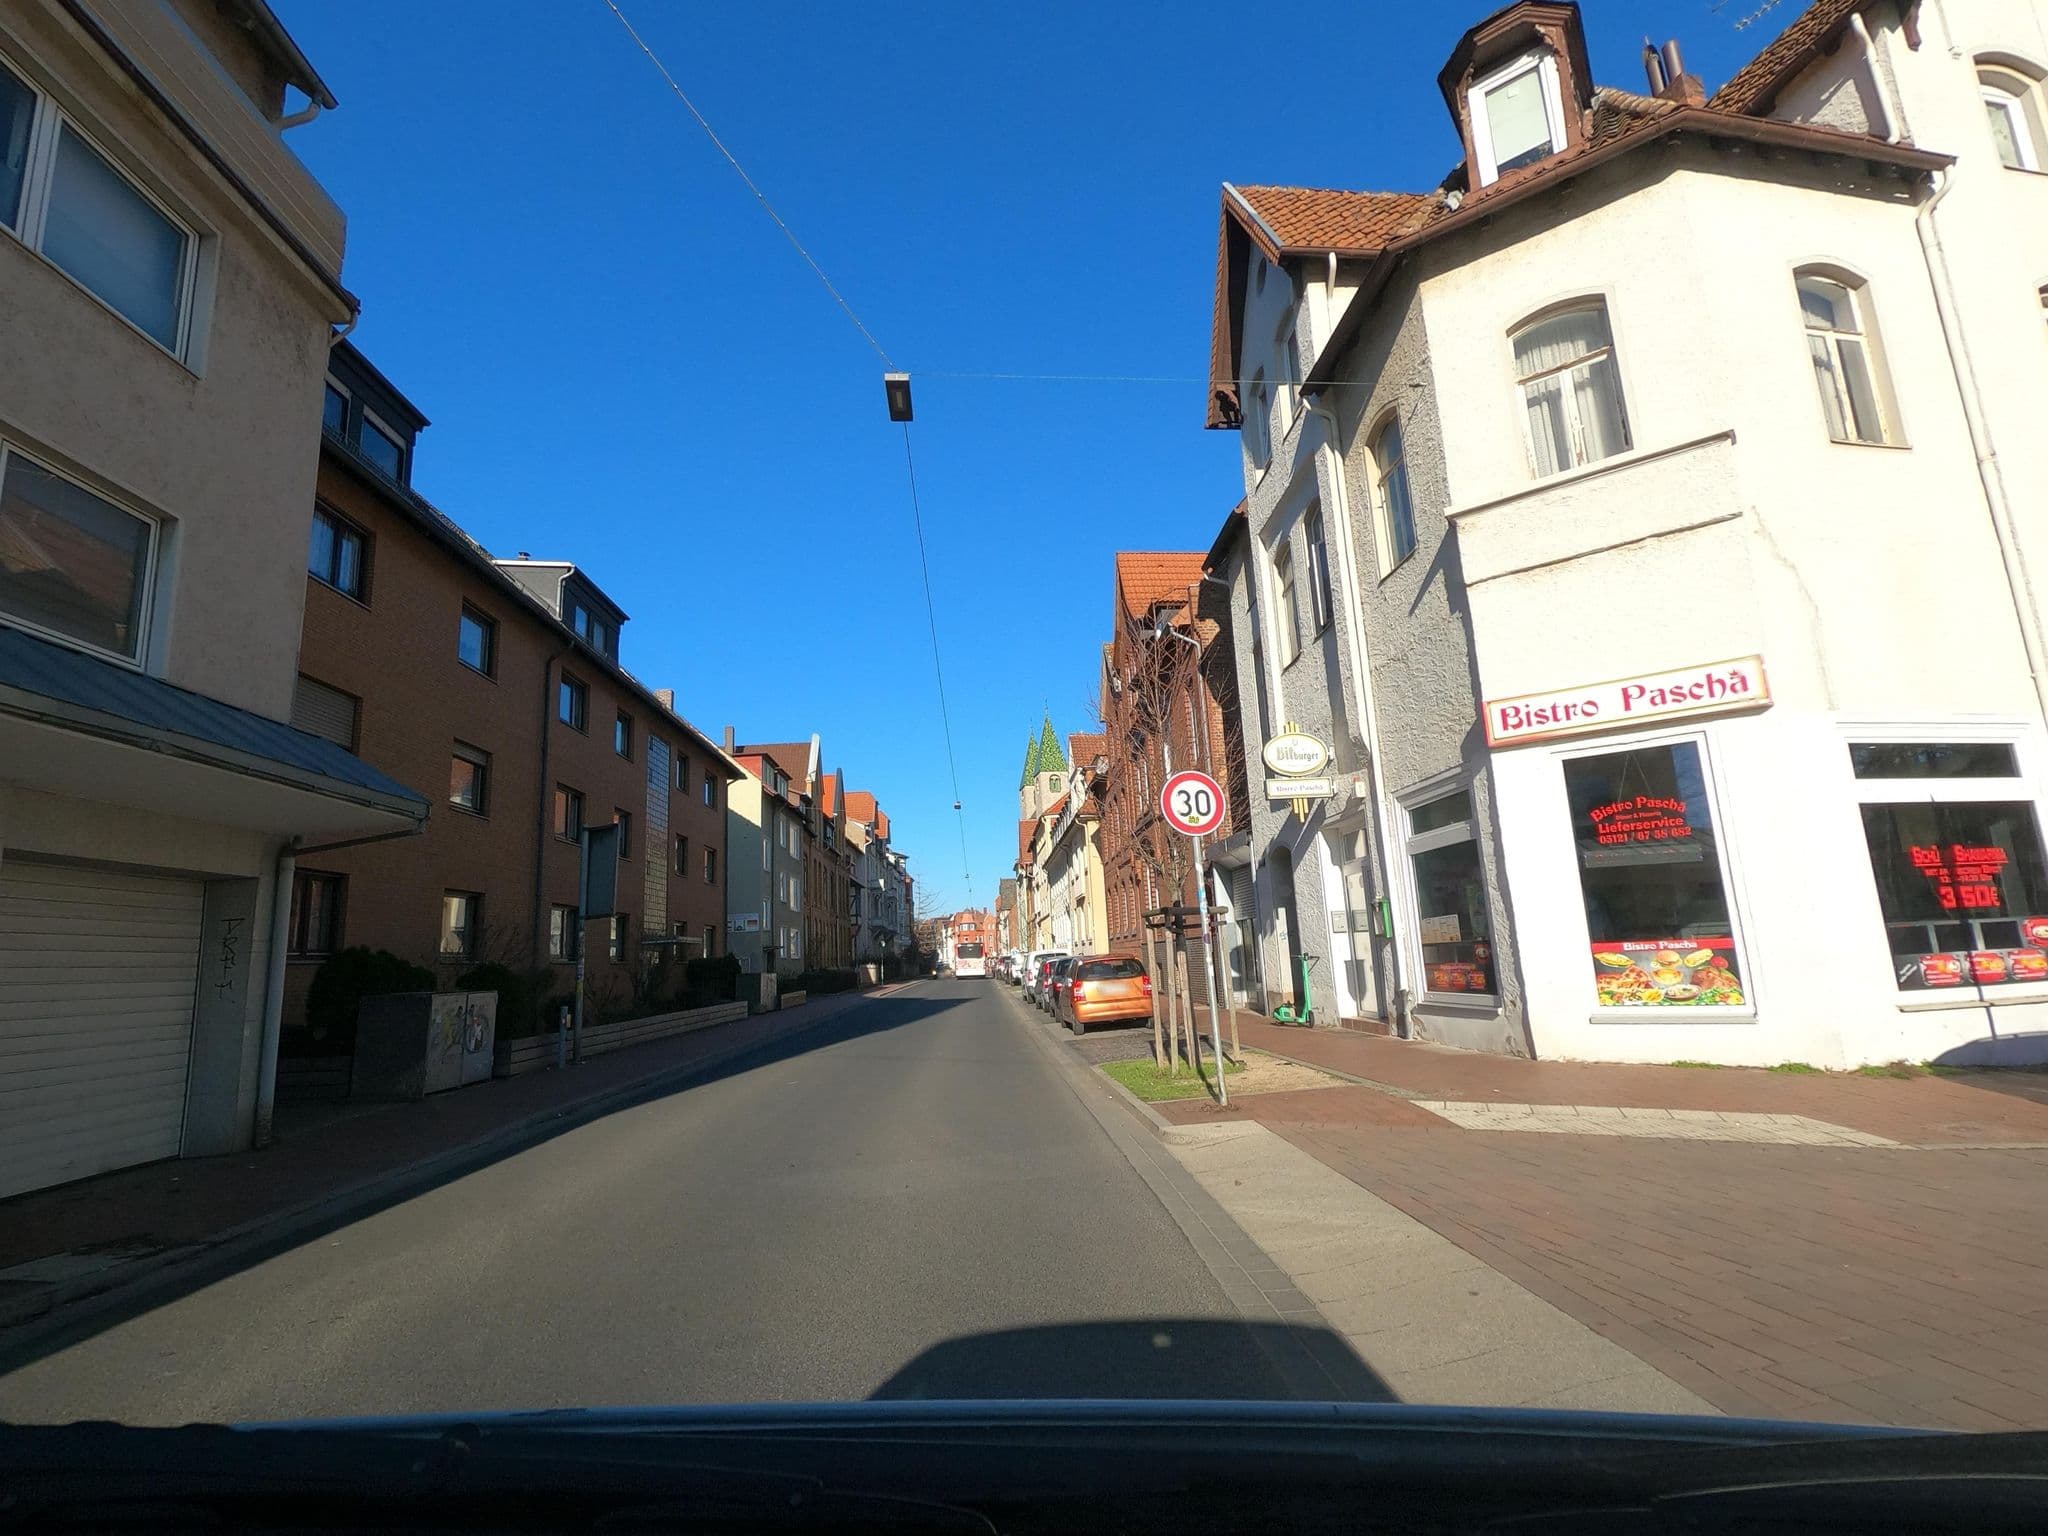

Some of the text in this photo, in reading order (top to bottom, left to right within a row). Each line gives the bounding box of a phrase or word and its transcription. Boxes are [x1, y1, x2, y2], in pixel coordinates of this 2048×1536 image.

[1500, 700, 1599, 731] Bistro
[1177, 789, 1211, 817] 30
[1590, 801, 1633, 822] Bistro
[1636, 796, 1686, 813] Pascha
[1598, 817, 1684, 834] Lieferservice
[1623, 940, 1698, 950] Bistro Pascha
